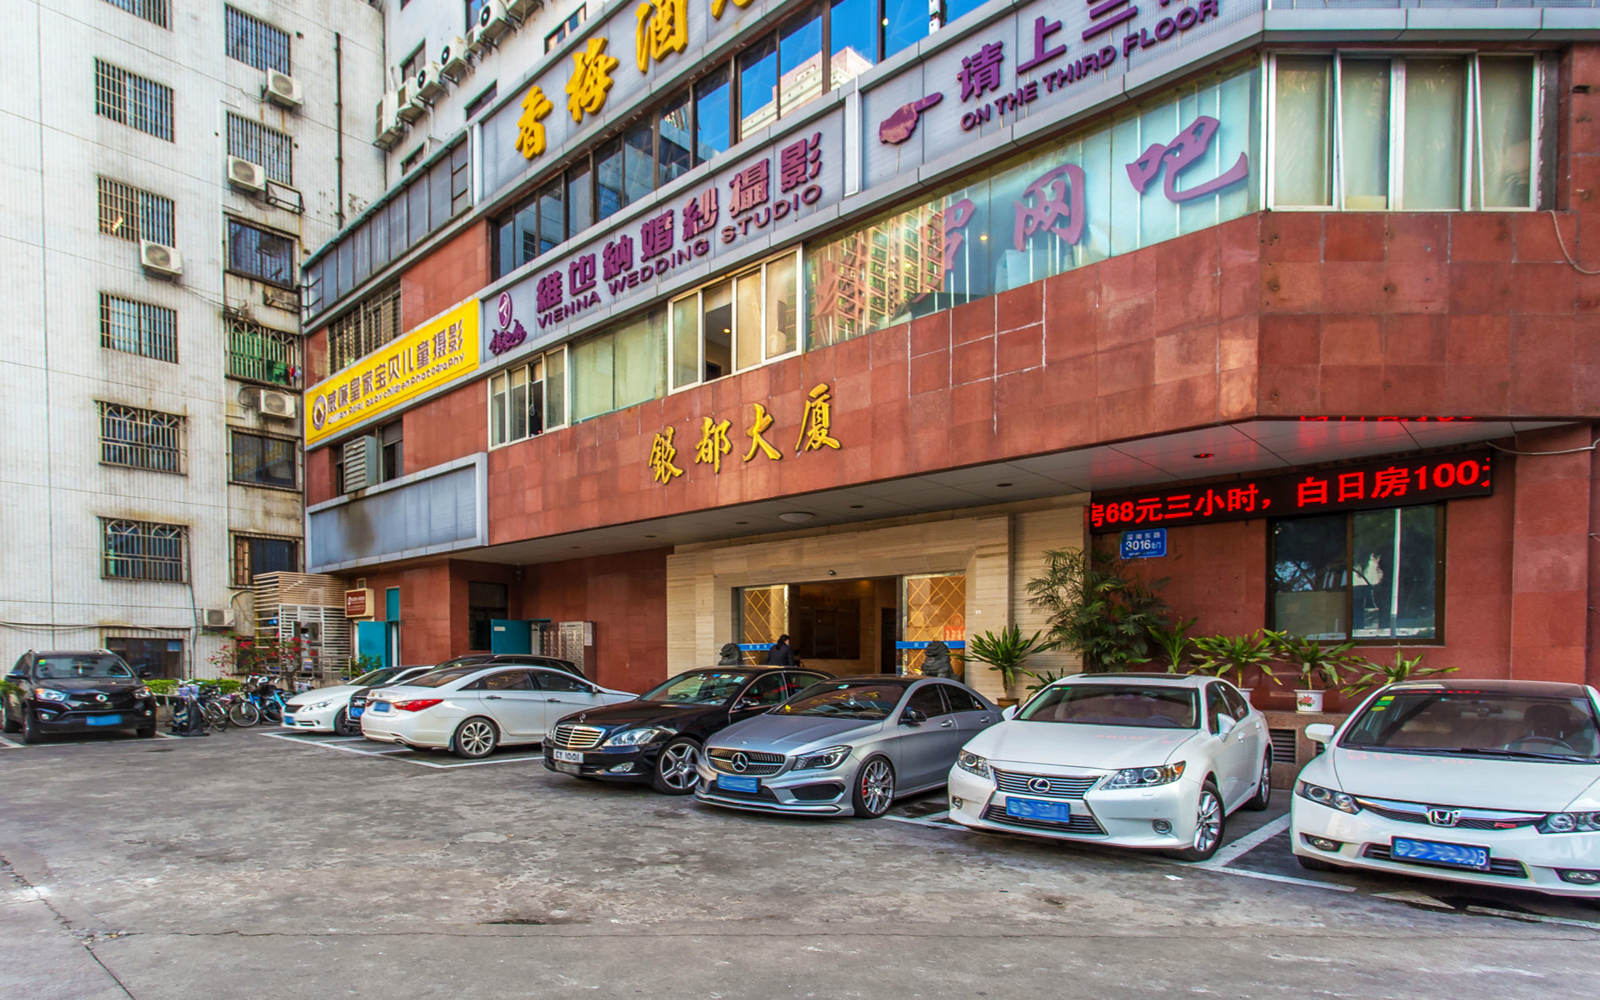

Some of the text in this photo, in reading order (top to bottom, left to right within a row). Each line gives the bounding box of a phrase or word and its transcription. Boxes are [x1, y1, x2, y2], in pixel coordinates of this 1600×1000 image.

[957, 0, 1176, 102] 请上三
[960, 0, 1219, 131] ON THE THIRD FLOOR
[537, 183, 823, 329] VIENNA WEDDING STUDIO
